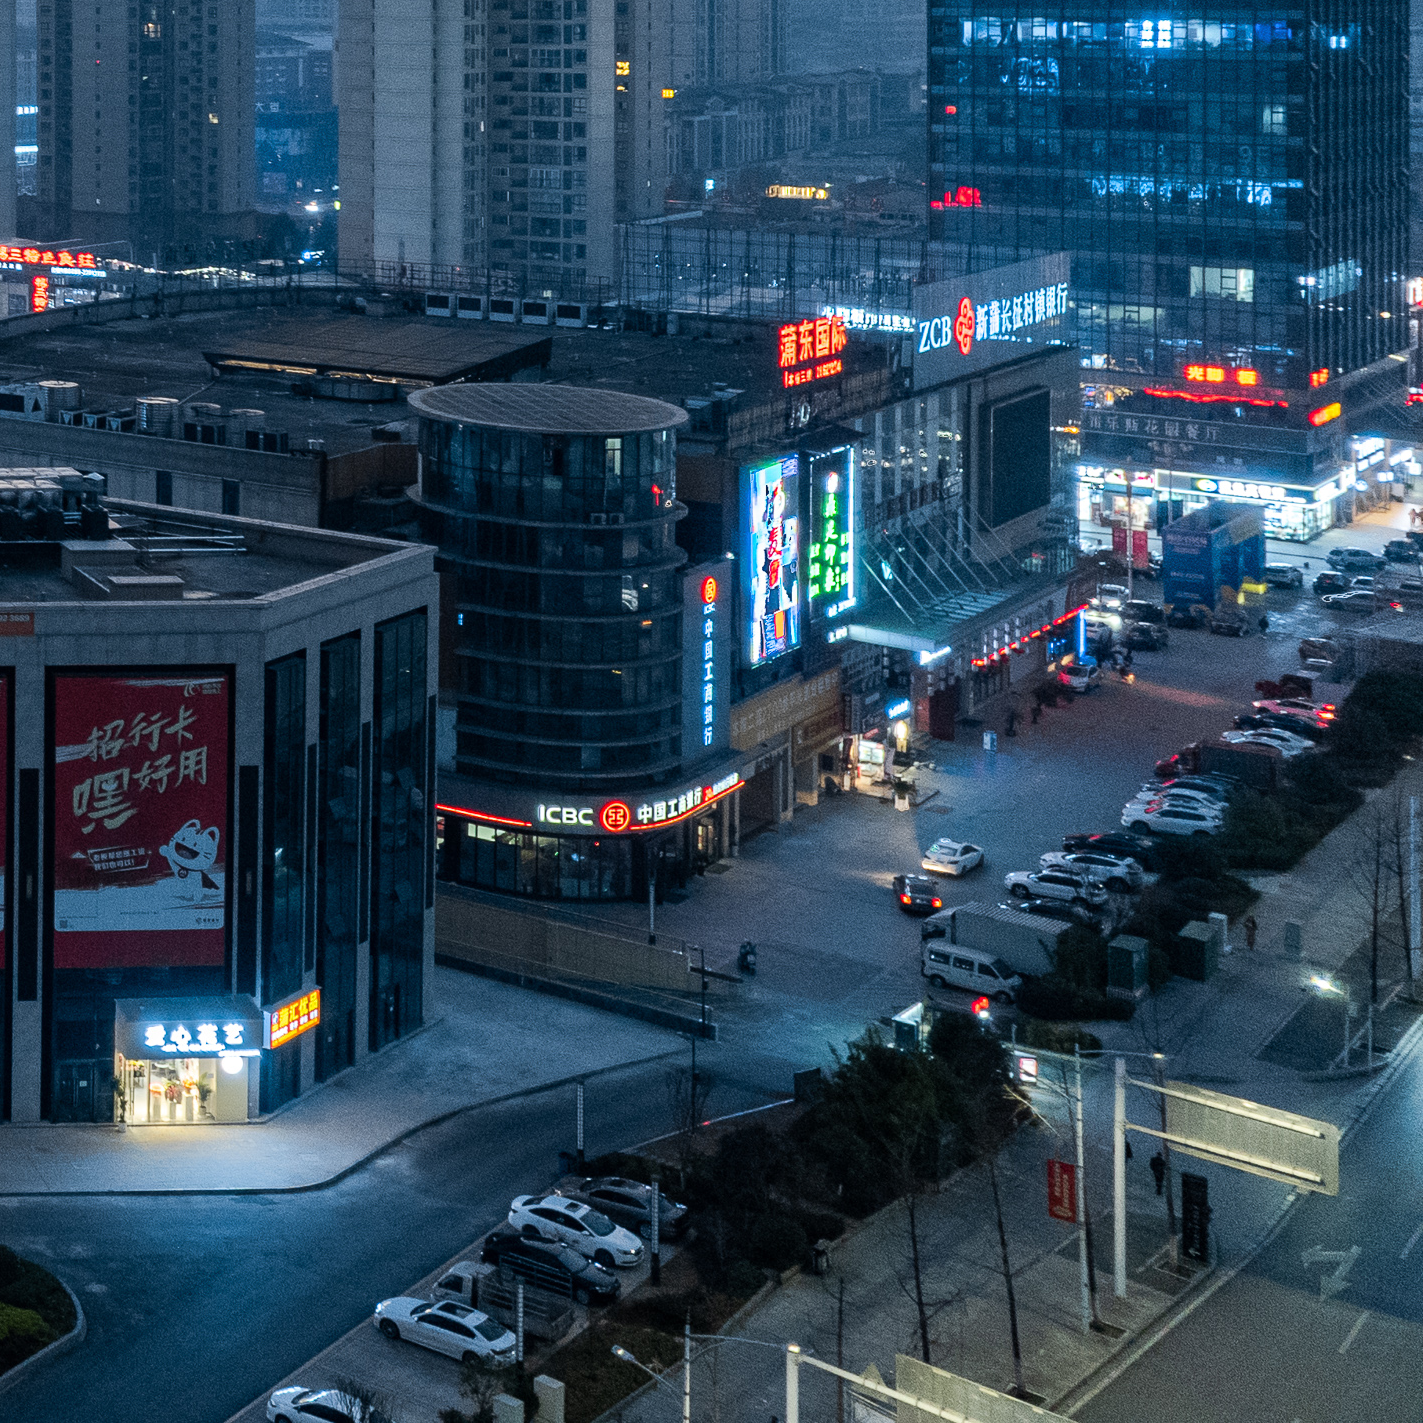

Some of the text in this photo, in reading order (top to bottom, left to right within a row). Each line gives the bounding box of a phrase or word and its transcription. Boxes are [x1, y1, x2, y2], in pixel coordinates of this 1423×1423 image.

[918, 315, 952, 354] ZCB
[974, 282, 1069, 342] 新蒲长征村镇银行
[779, 314, 847, 368] 蒲东国际
[703, 619, 714, 746] 中国工商银行
[87, 705, 198, 762] 招行卡
[73, 746, 208, 834] 嘿好用
[538, 804, 594, 826] ICBC
[637, 786, 702, 824] 中国工商银行
